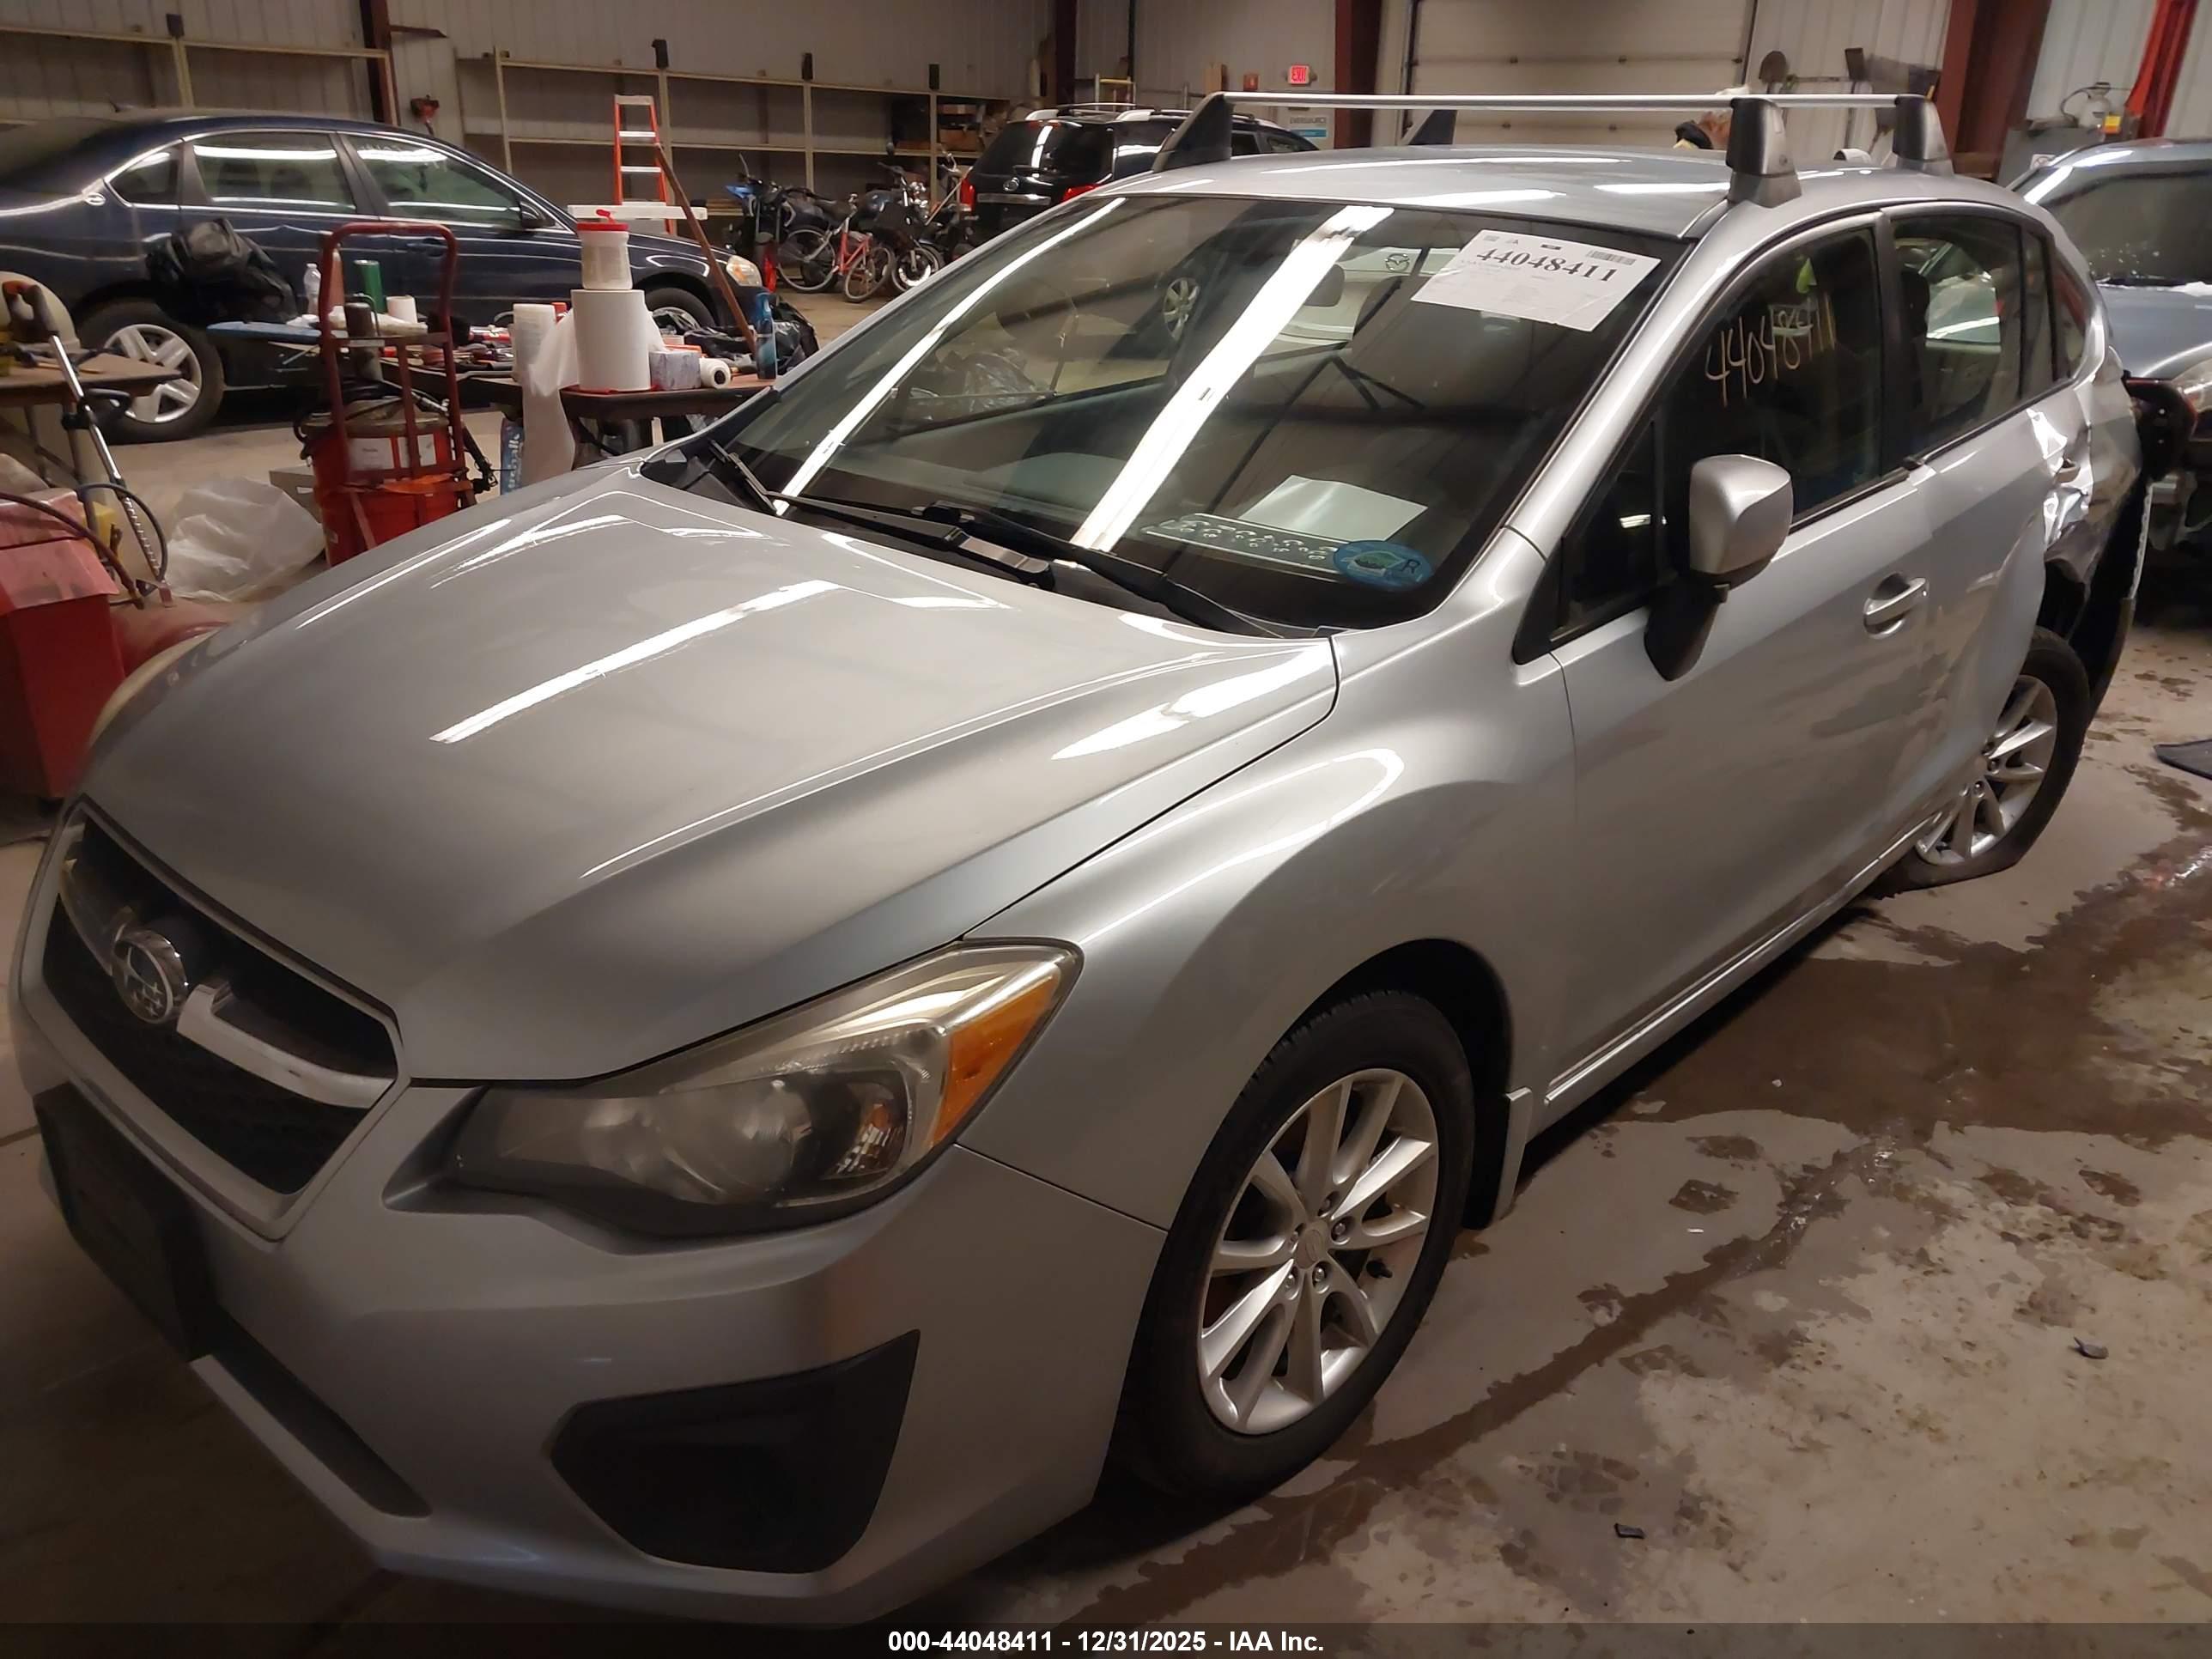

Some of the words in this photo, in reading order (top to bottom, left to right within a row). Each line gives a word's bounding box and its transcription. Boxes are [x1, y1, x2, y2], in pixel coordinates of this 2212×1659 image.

[1290, 66, 1306, 82] EXIT
[1476, 247, 1618, 283] 44048411
[1705, 293, 1836, 408] 44048411
